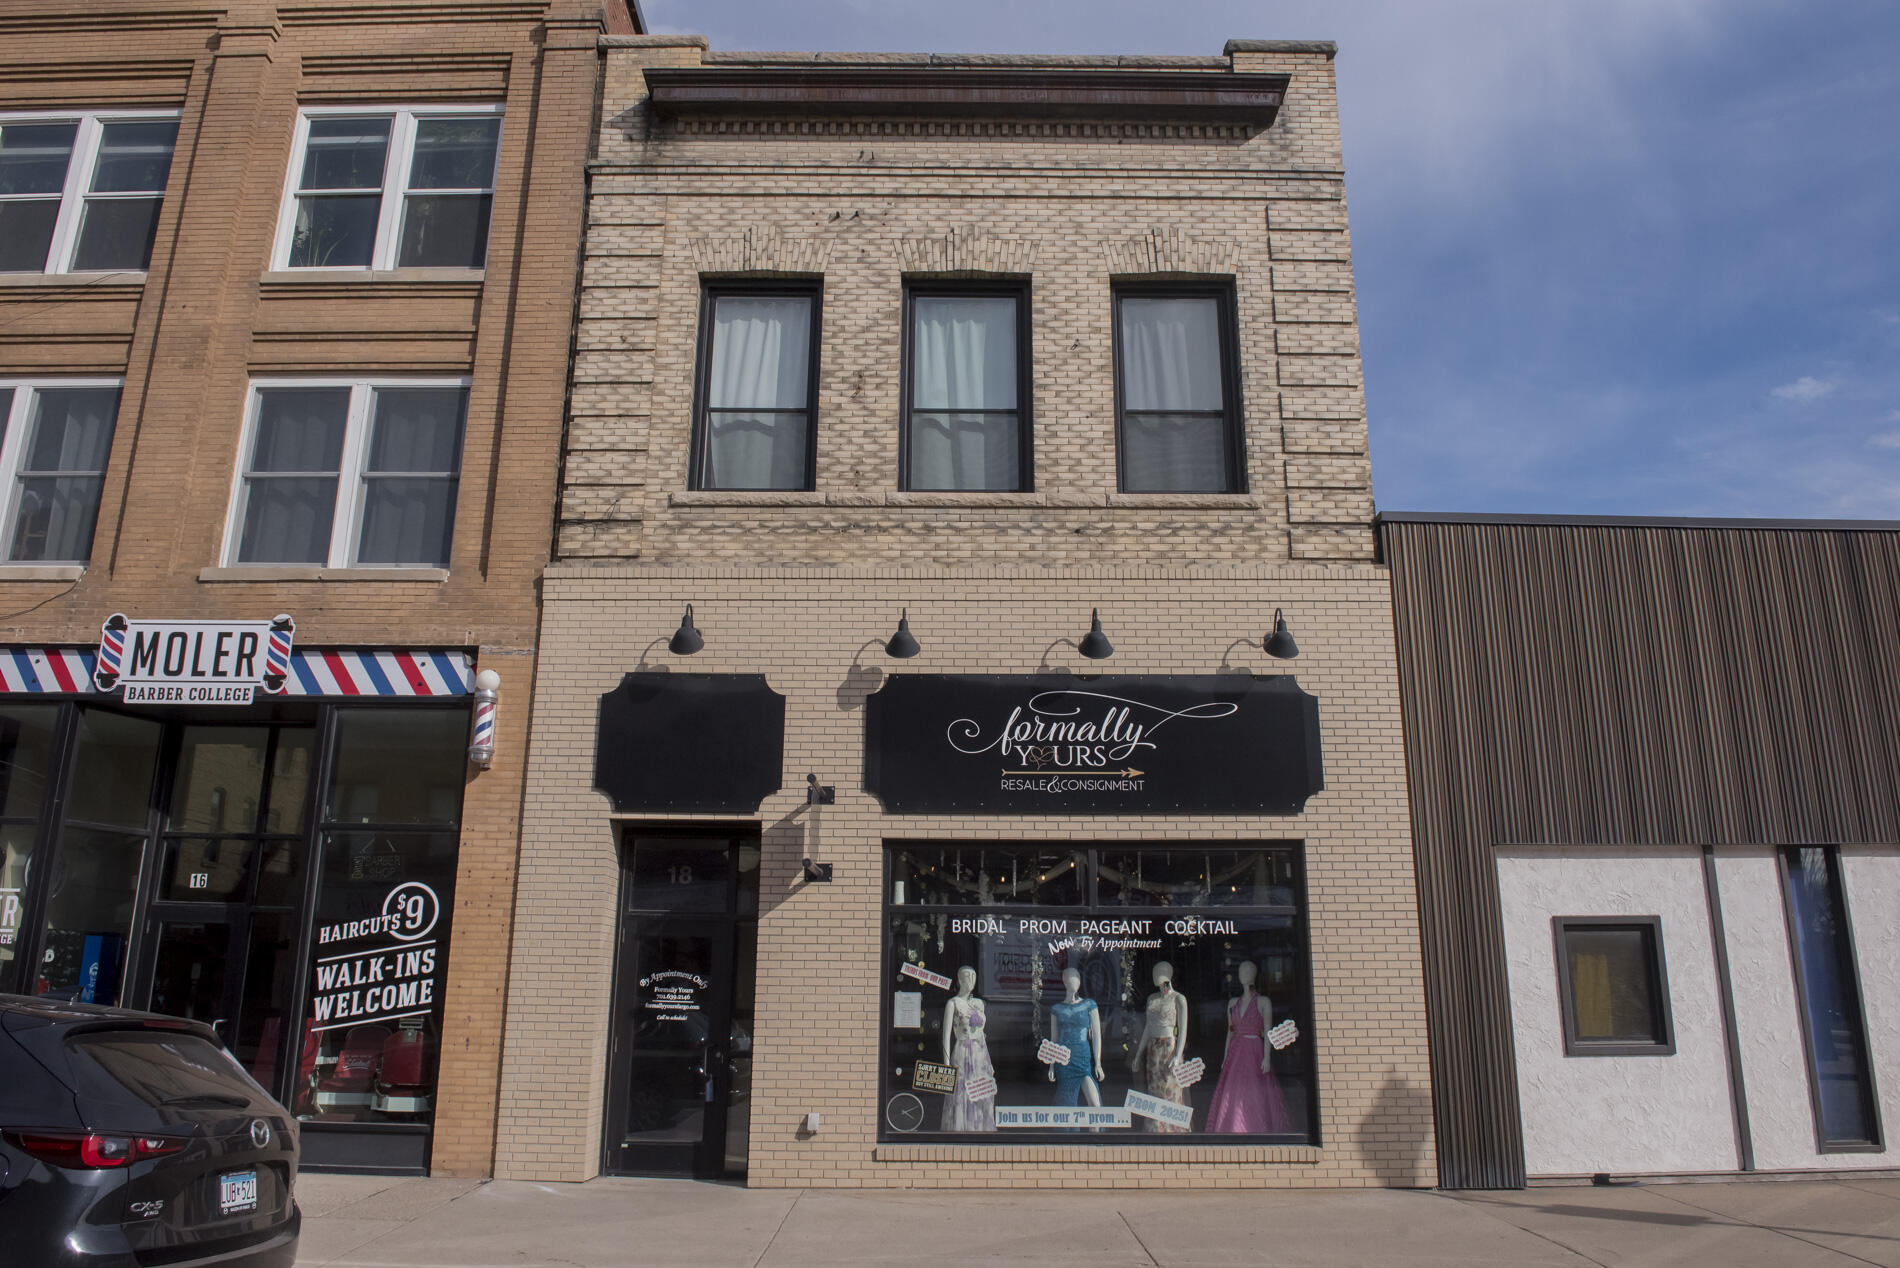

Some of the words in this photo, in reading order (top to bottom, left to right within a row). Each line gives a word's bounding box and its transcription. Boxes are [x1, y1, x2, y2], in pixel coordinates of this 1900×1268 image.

[129, 631, 259, 677] MOLER
[127, 686, 183, 701] BARBER
[188, 687, 251, 701] COLLEGE
[1001, 779, 1046, 791] RESALE
[1061, 779, 1145, 791] CONSIGNMENT
[192, 874, 206, 887] 16
[667, 865, 692, 884] 18
[319, 913, 401, 944] HAIRCUTS
[397, 893, 425, 929] $9
[952, 919, 1007, 934] BRIDAL
[1019, 919, 1067, 934] PROM
[1080, 919, 1152, 934] PAGEANT
[1164, 920, 1239, 935] COCKTAIL
[1095, 936, 1162, 952] Appointment
[316, 948, 437, 991] WALK-INS
[650, 969, 693, 983] Appointment
[314, 978, 434, 1022] WELCOME
[918, 1063, 937, 1073] SORRY
[916, 1070, 955, 1087] CLOSED
[1127, 1095, 1158, 1113] PROM
[998, 1111, 1018, 1123] Join
[1022, 1113, 1033, 1123] us
[1035, 1111, 1049, 1123] for
[1053, 1113, 1069, 1123] our
[1088, 1113, 1115, 1126] prom
[130, 1199, 164, 1212] CX-5
